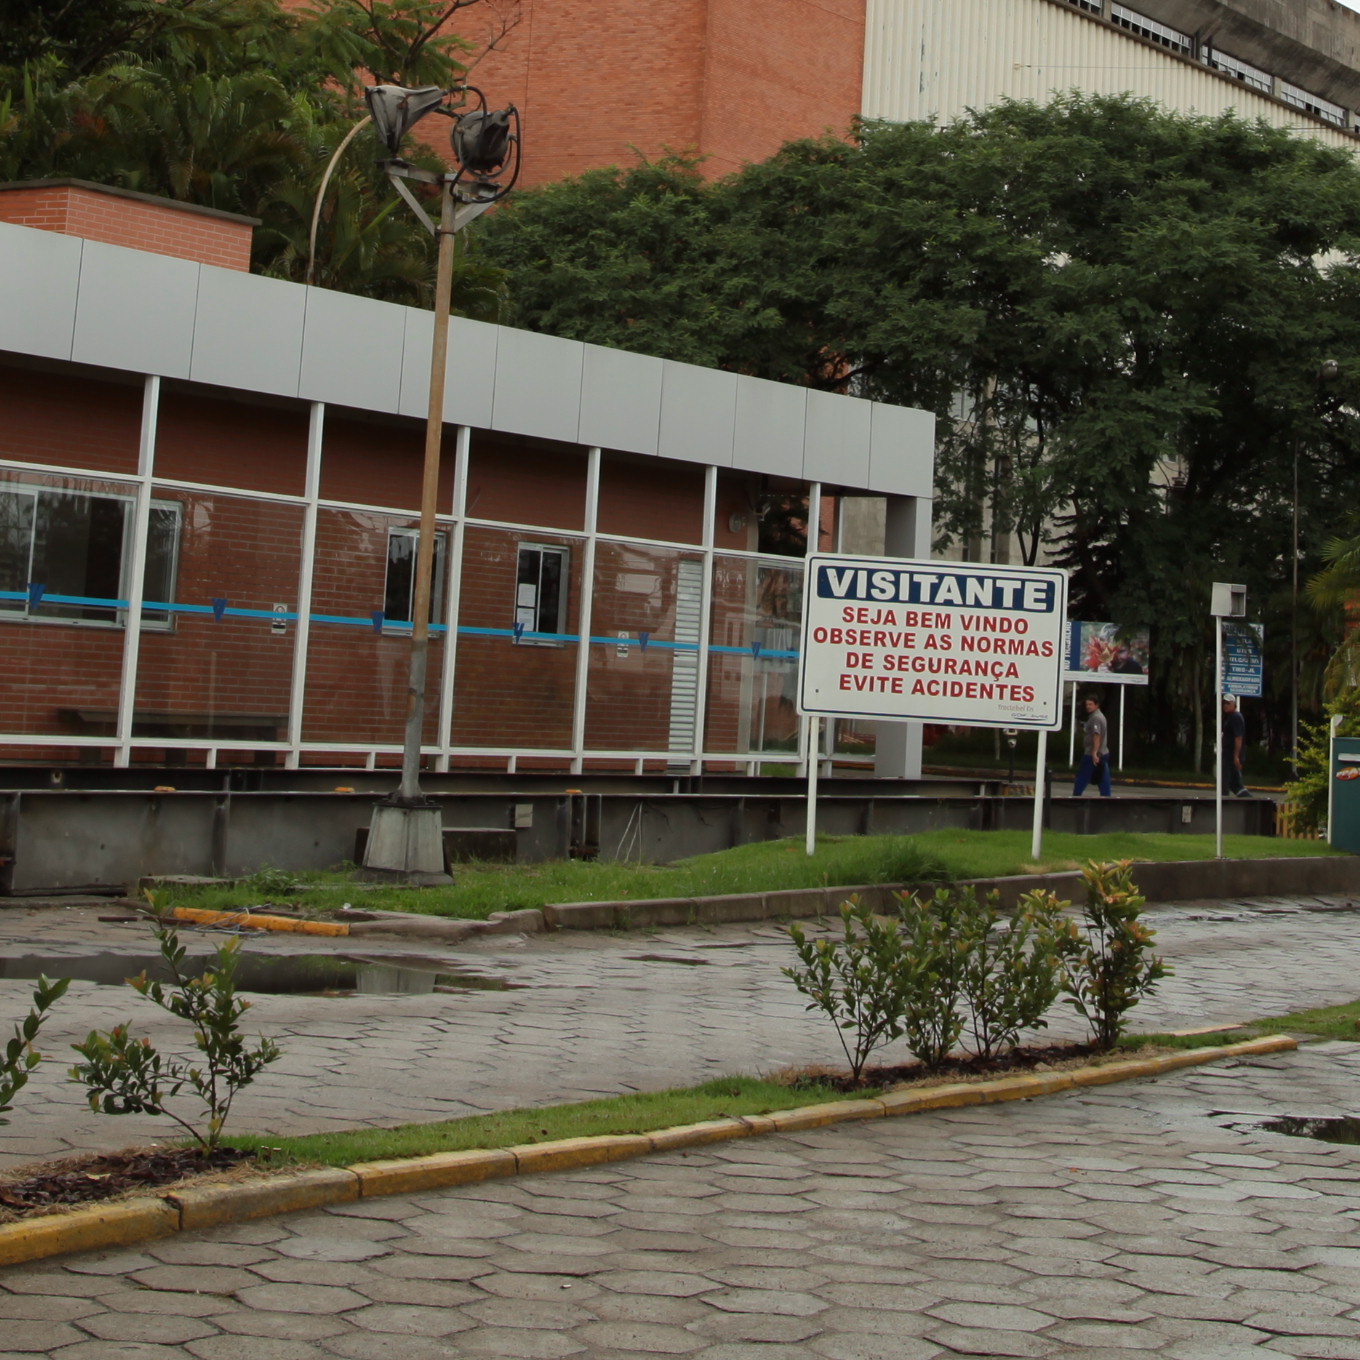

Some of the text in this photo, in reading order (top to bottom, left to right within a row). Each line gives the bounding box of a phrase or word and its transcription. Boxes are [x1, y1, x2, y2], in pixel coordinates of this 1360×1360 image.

[826, 568, 1048, 611] VISITANTE
[842, 606, 1029, 635] SEJA BEM VINDO
[813, 627, 1054, 658] OBSERVE AS NORMAS
[846, 652, 1020, 682] DE SEGURANÇA
[839, 674, 1035, 703] EVITE ACIDENTES
